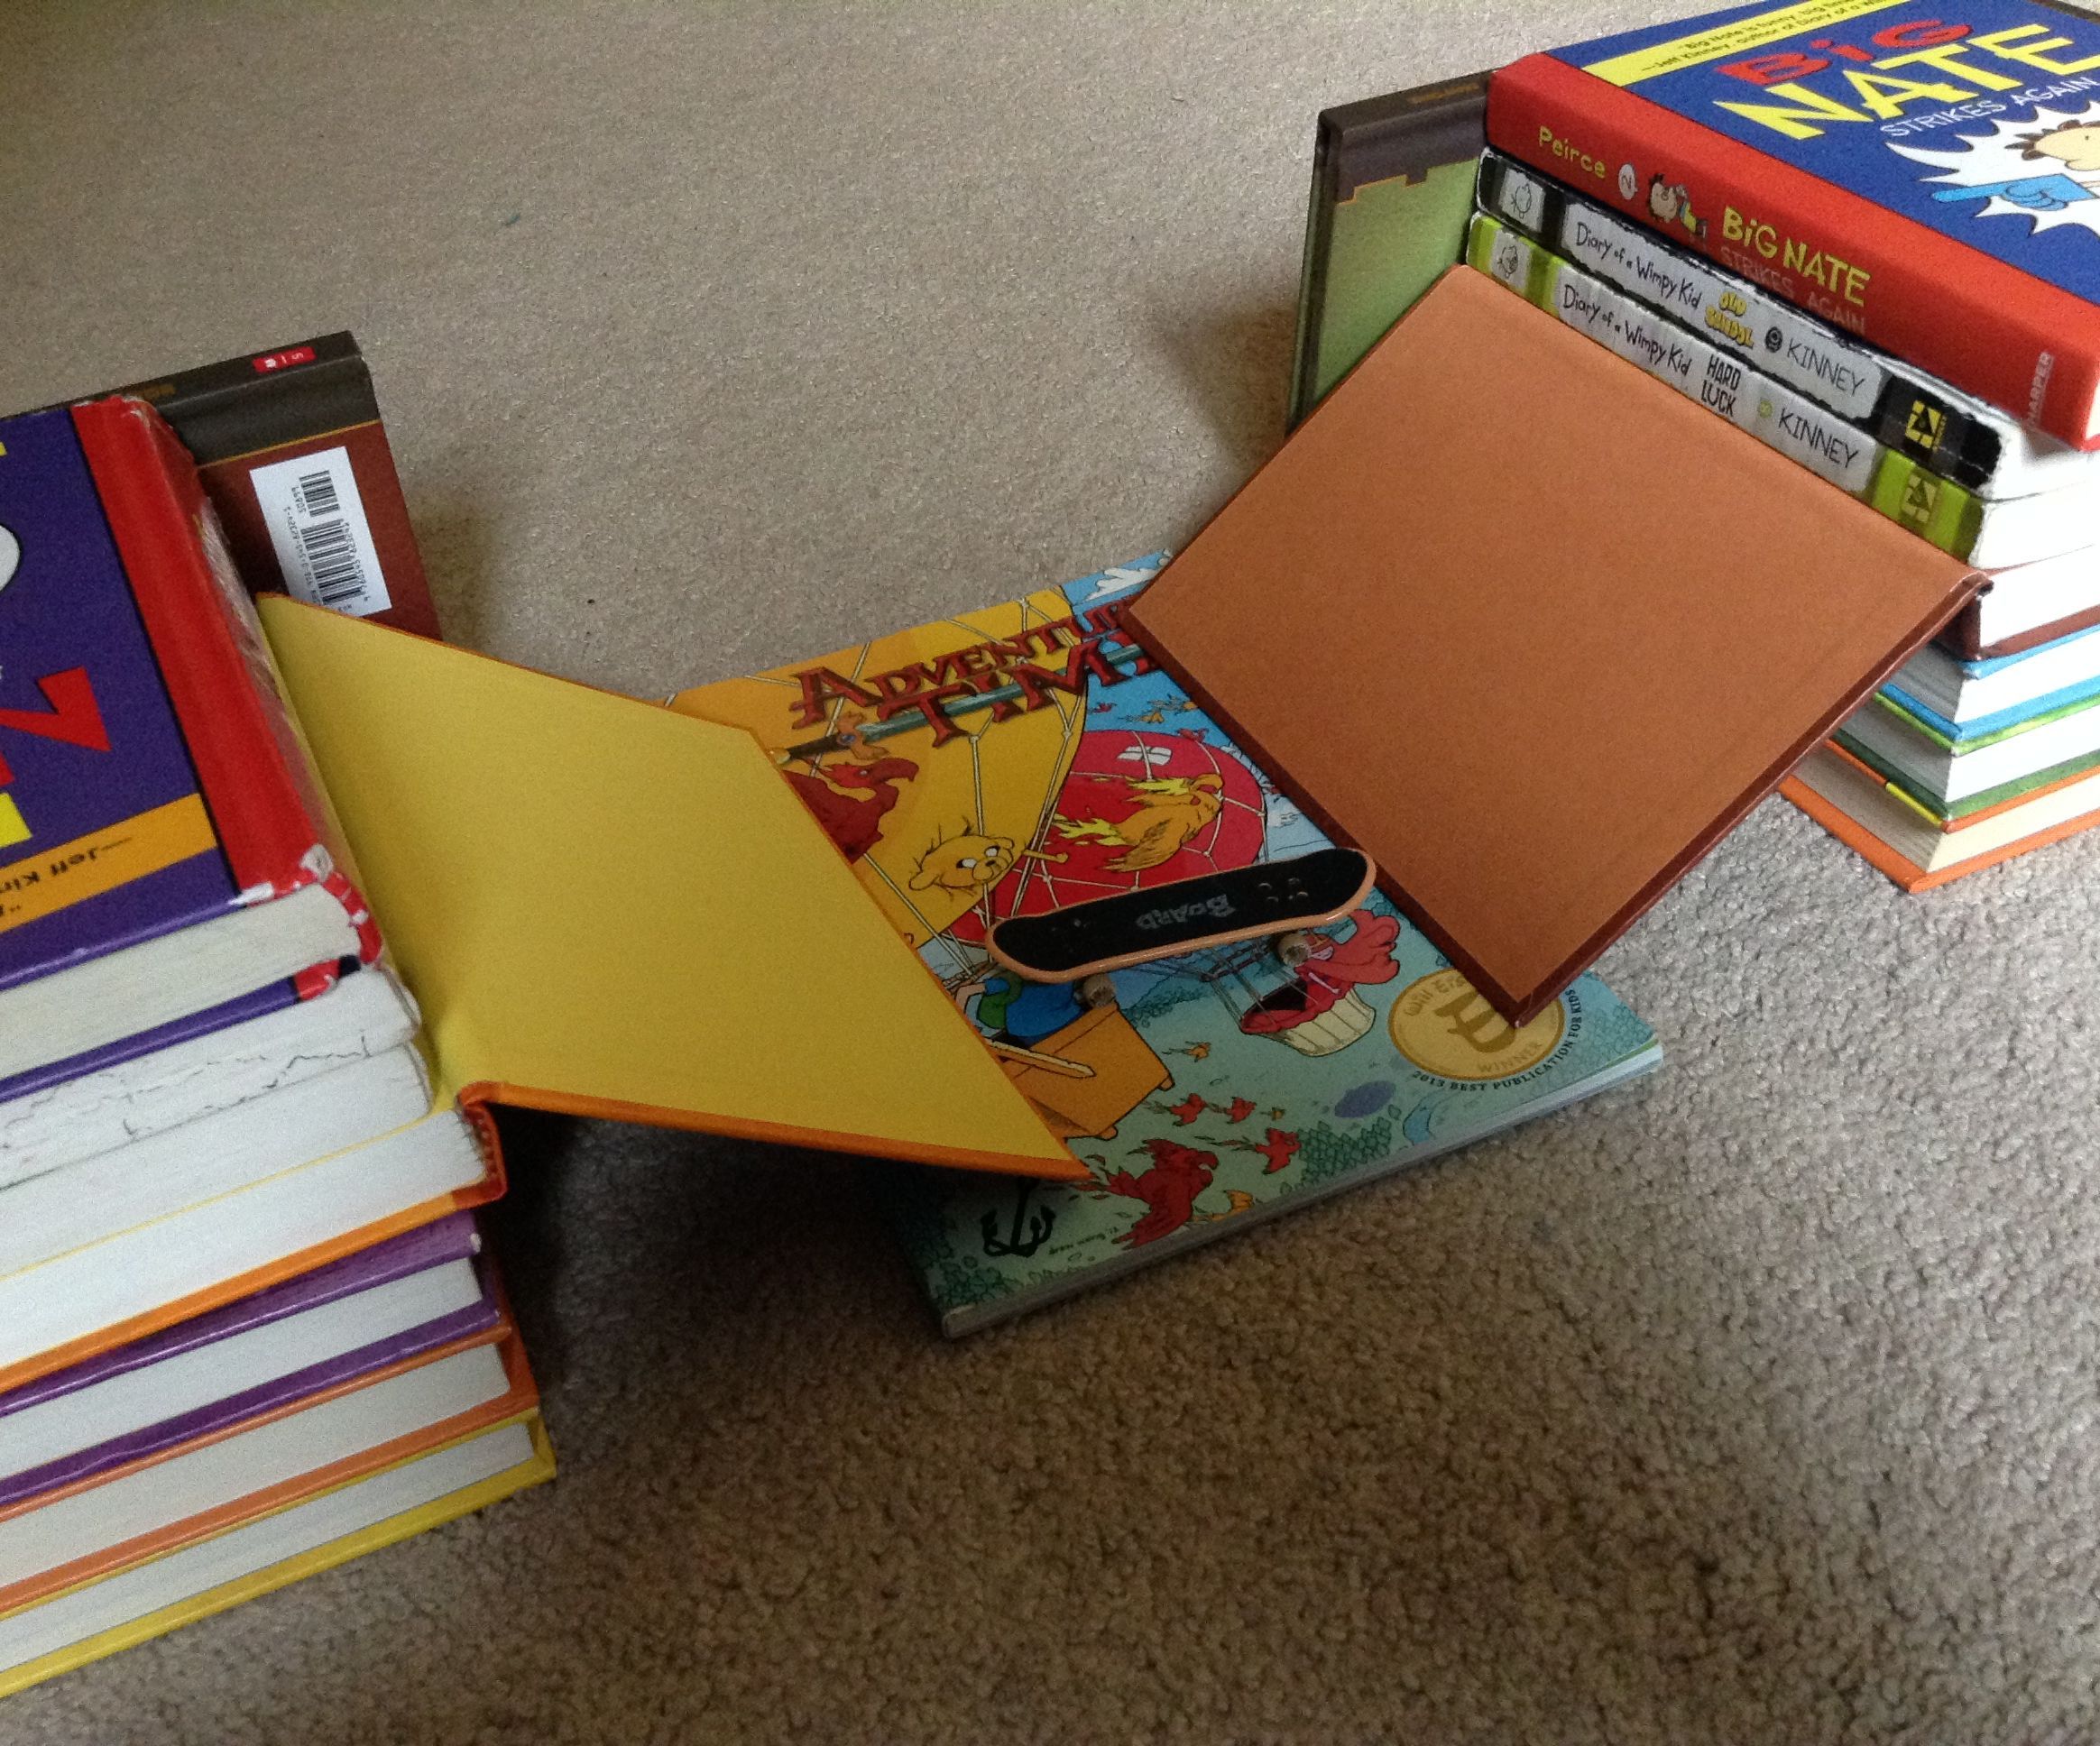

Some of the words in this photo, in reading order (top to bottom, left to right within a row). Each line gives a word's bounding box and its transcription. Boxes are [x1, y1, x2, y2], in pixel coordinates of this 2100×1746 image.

[1712, 23, 2100, 140] NATE
[1880, 100, 2007, 136] STRIKES
[2010, 76, 2100, 106] AGAIN
[1538, 125, 1607, 179] Peirce
[1576, 222, 1613, 261] Diary
[1614, 248, 1626, 264] of
[1626, 260, 1634, 270] a
[1636, 256, 1678, 299] Wimpy
[1679, 278, 1702, 310] Kid
[1720, 245, 1795, 299] STRIKES
[1808, 290, 1865, 335] AGAIN
[1782, 237, 1872, 308] NATE
[1563, 284, 1601, 324] Diary
[1601, 311, 1614, 327] of
[1615, 325, 1622, 334] a
[1625, 320, 1667, 365] Wimpy
[1668, 343, 1692, 377] Kid
[1706, 353, 1742, 391] HARD
[1786, 337, 1865, 398] KINNEY
[1700, 379, 1737, 418] LUCK
[1778, 407, 1859, 469] KINNEY
[789, 596, 1131, 730] ADVENTUR
[1565, 988, 1582, 1015] KIDS
[1568, 1016, 1583, 1039] FOR
[1413, 1070, 1445, 1088] 2013
[1450, 1081, 1488, 1092] BEST
[1493, 1040, 1575, 1091] PUBLICATION
